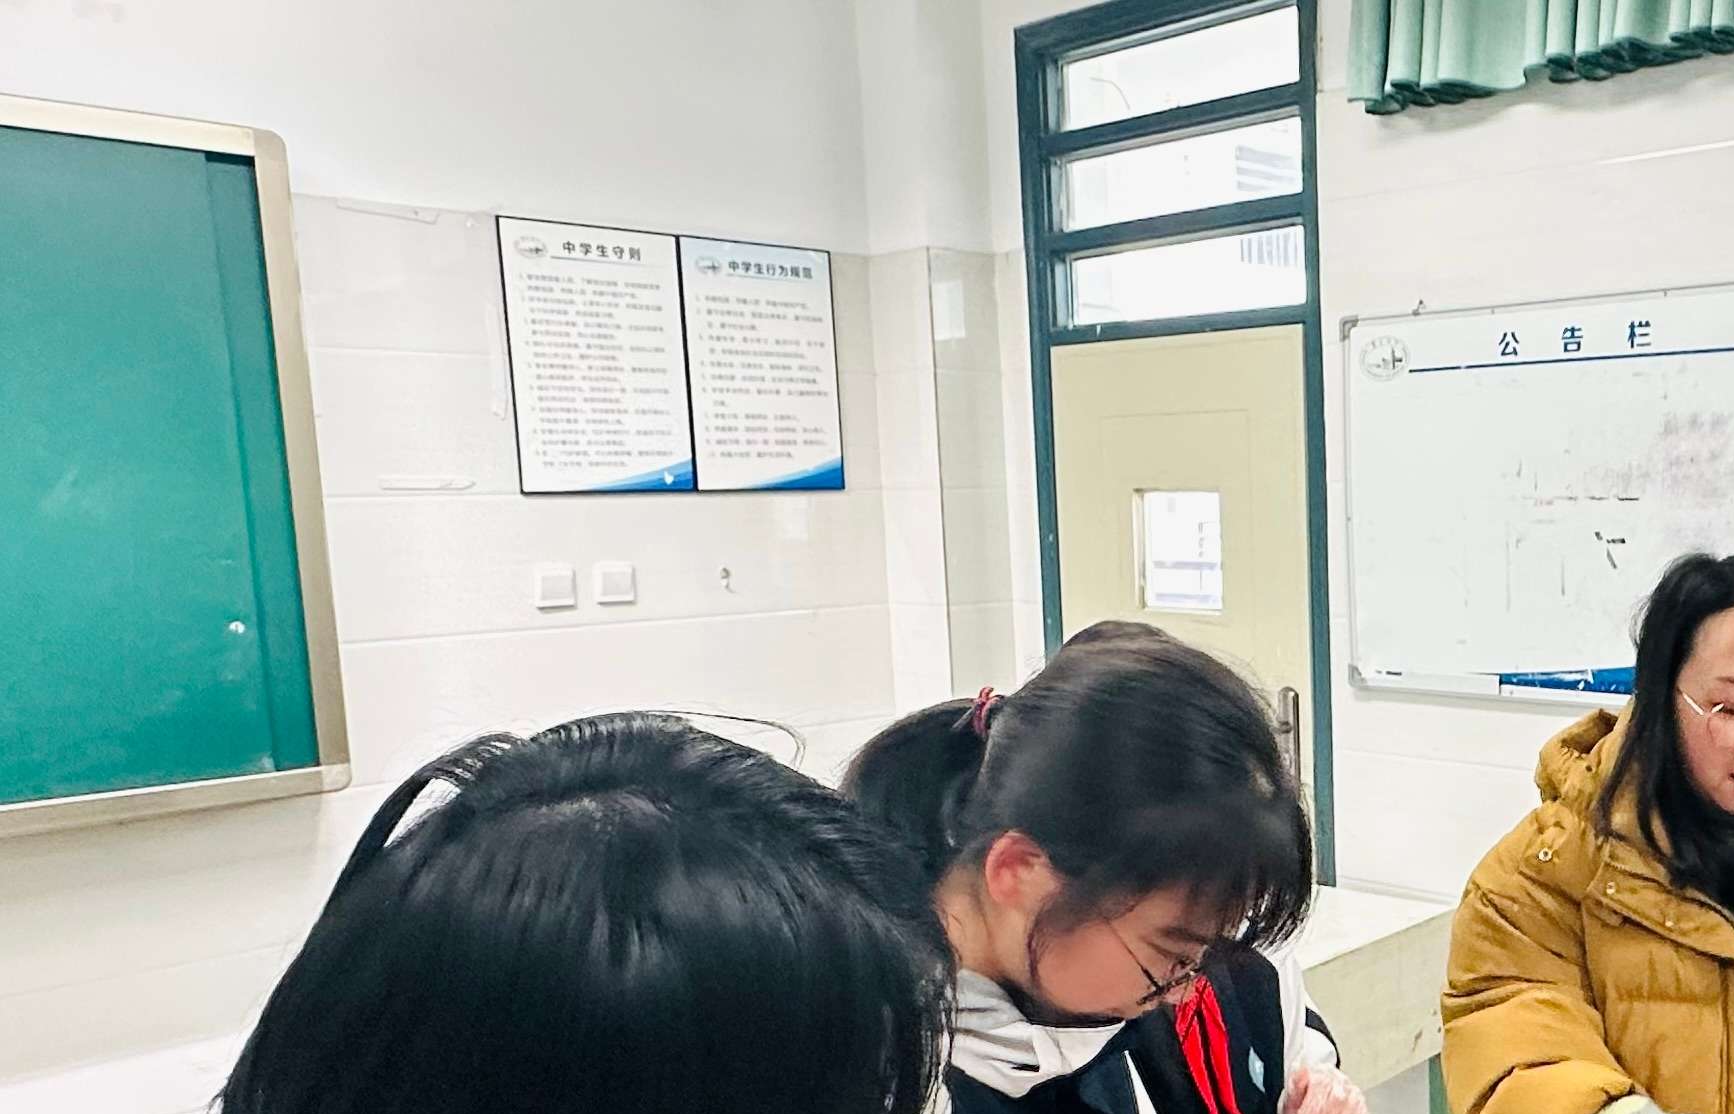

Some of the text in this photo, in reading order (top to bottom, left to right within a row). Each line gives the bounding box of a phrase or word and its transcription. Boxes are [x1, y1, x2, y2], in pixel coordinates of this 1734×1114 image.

[562, 241, 641, 261] 中学生守则
[728, 261, 813, 280] 中学生行为规范
[1498, 320, 1652, 357] 公告栏
